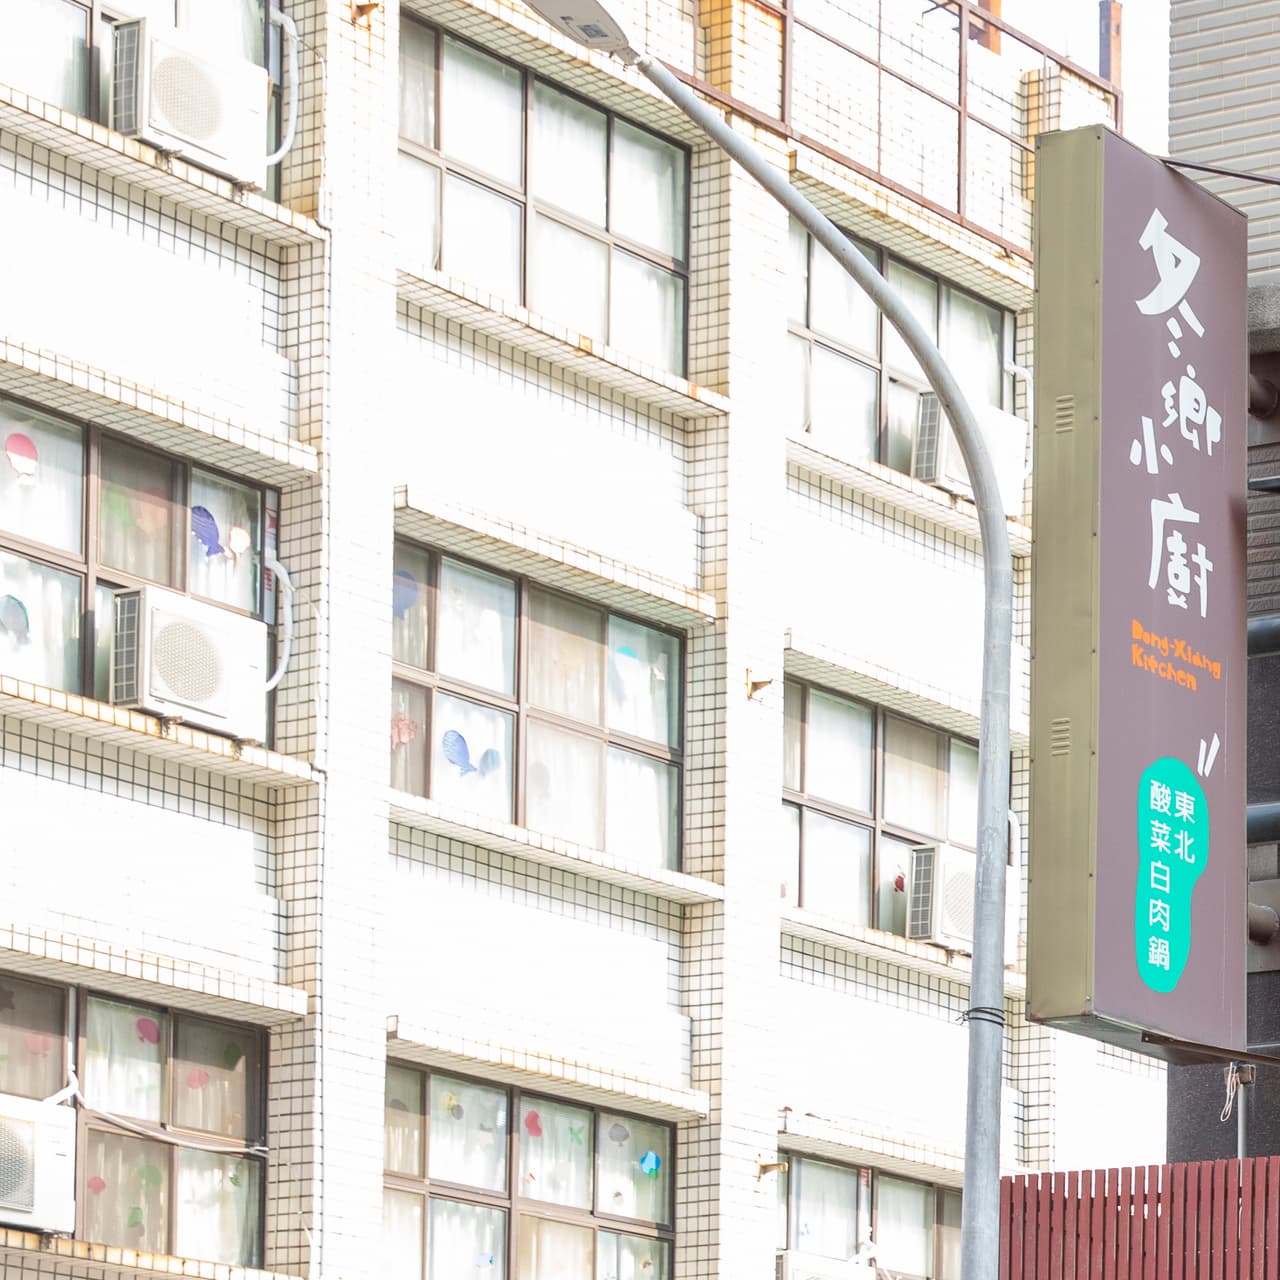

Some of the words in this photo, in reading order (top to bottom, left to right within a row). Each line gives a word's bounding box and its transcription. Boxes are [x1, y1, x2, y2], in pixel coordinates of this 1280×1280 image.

[1132, 643, 1197, 691] Kitchen
[1174, 790, 1196, 864] 東北
[1147, 779, 1171, 971] 酸菜白肉鍋
